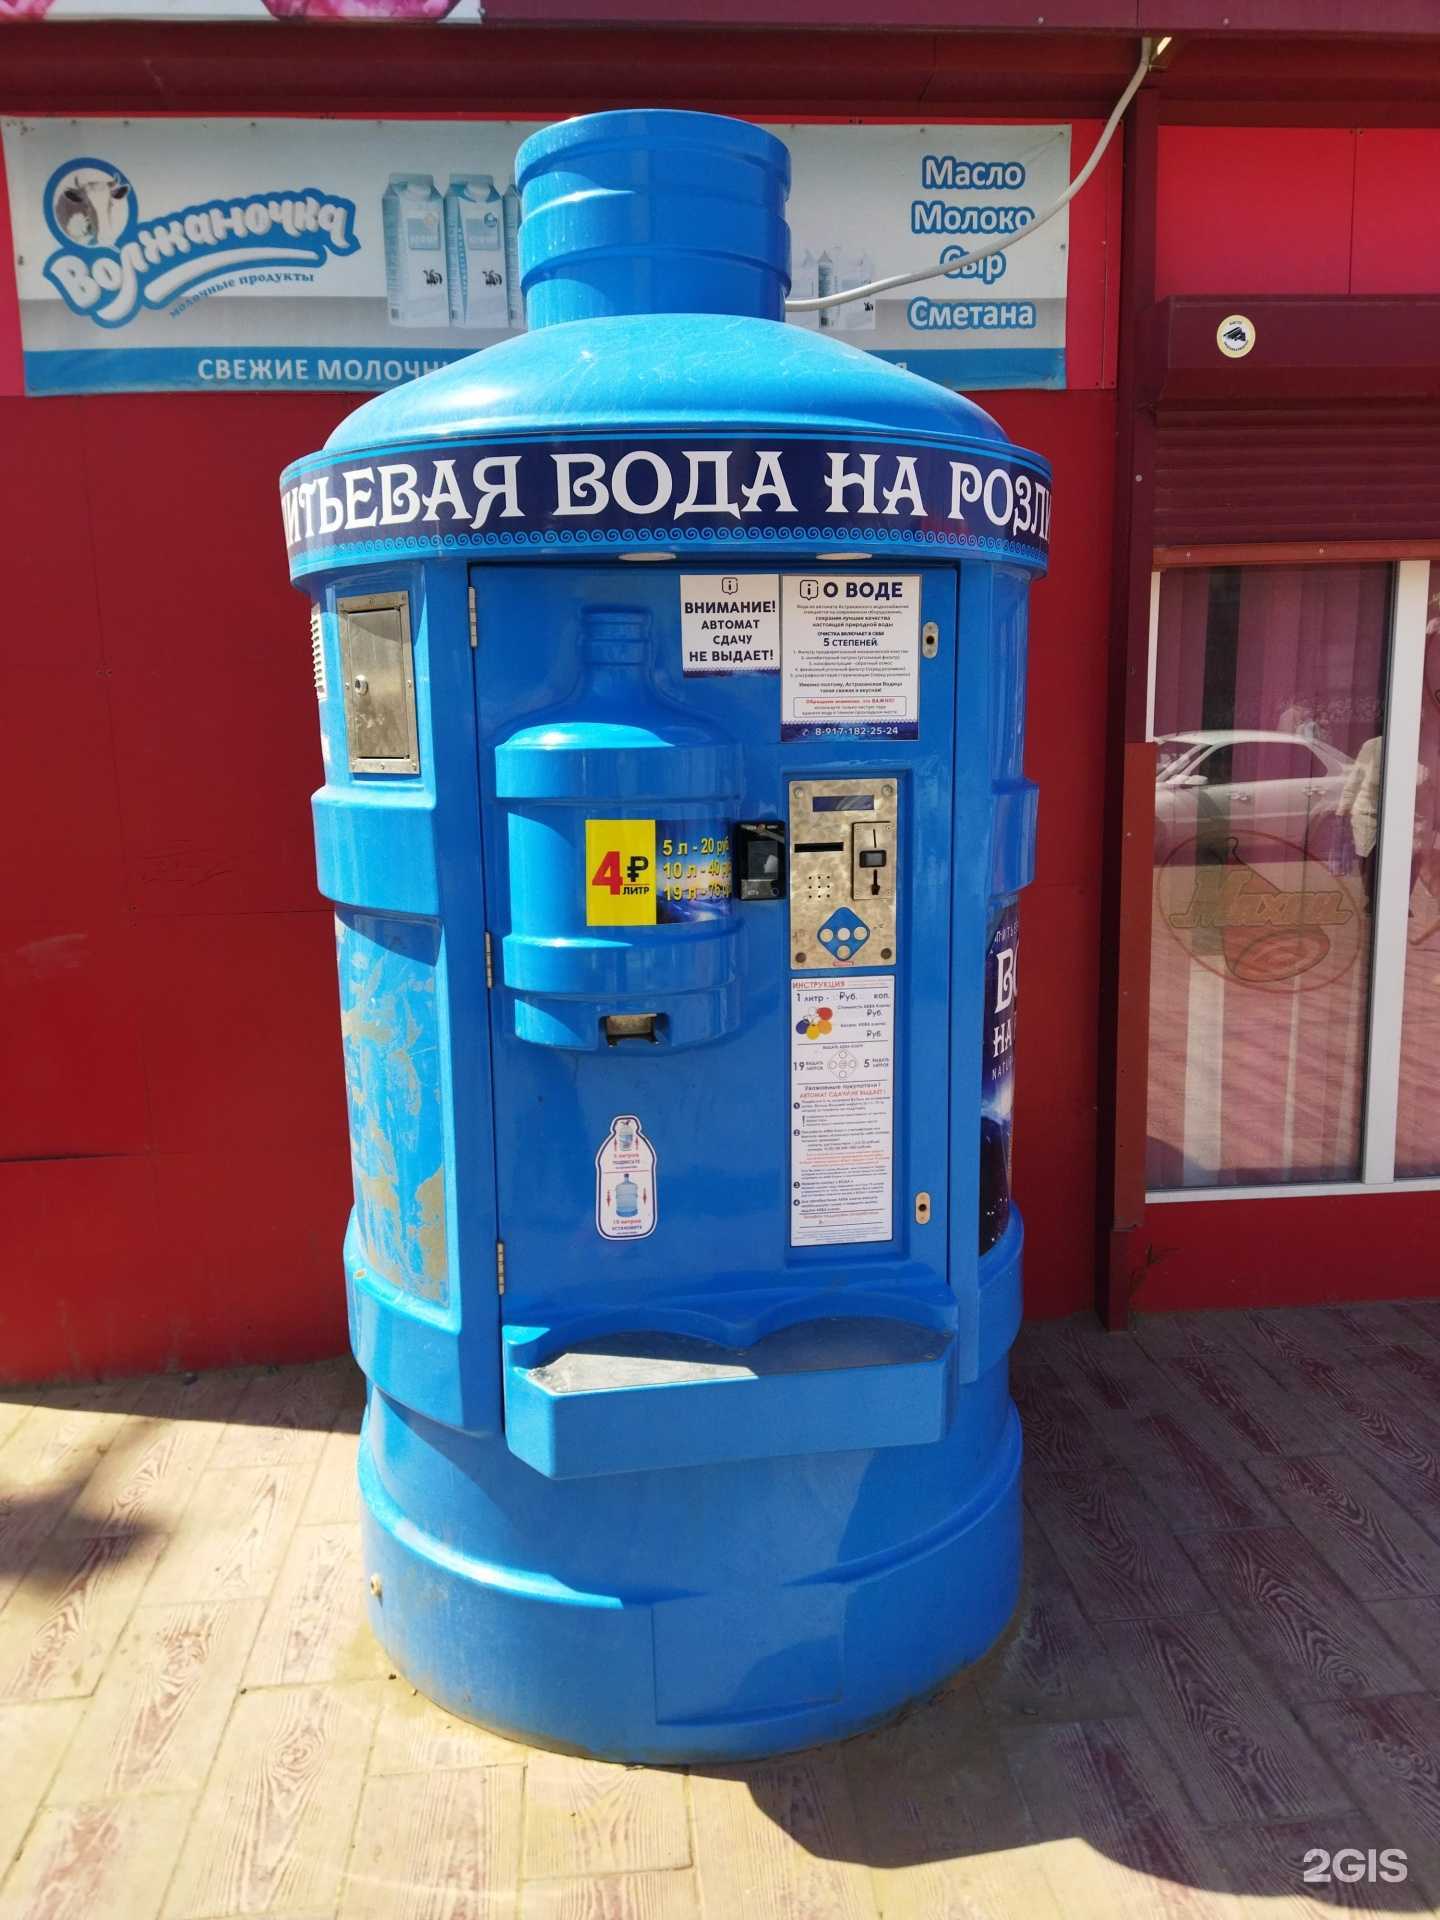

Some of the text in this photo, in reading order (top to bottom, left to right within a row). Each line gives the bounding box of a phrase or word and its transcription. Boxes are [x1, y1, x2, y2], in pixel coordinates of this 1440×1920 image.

[923, 157, 1024, 187] Масло
[911, 202, 1034, 232] Молоко
[46, 193, 354, 324] Волжаночка
[168, 271, 315, 319] молочные продукты
[909, 299, 1034, 328] Сметана
[197, 358, 452, 381] СВЕЖИЕ МОЛОЧН
[282, 454, 526, 547] ИТЬЕВАЯ
[549, 449, 799, 521] ВОДА
[823, 451, 929, 518] НА
[822, 581, 904, 601] О ВОДЕ
[684, 600, 776, 615] ВНИМАНИЕ!
[701, 619, 760, 631] АВТОМАТ
[713, 634, 752, 647] СДАЧУ
[823, 637, 879, 647] 5 СТЕПЕНЕЙ
[689, 649, 775, 663] НЕ ВЫДАЕТ!
[815, 726, 899, 736] 8-917-182-25-24
[661, 839, 674, 857] 5
[676, 843, 689, 856] л
[701, 837, 715, 854] 20
[591, 850, 624, 896] 4
[663, 862, 683, 879] 10
[686, 864, 698, 878] л
[622, 885, 650, 896] ЛИТР
[663, 884, 683, 902] 19
[792, 981, 846, 989] ИНСТРУКЦИЯ
[796, 992, 801, 1003] 1
[793, 1061, 805, 1072] 19
[863, 1058, 871, 1068] 5
